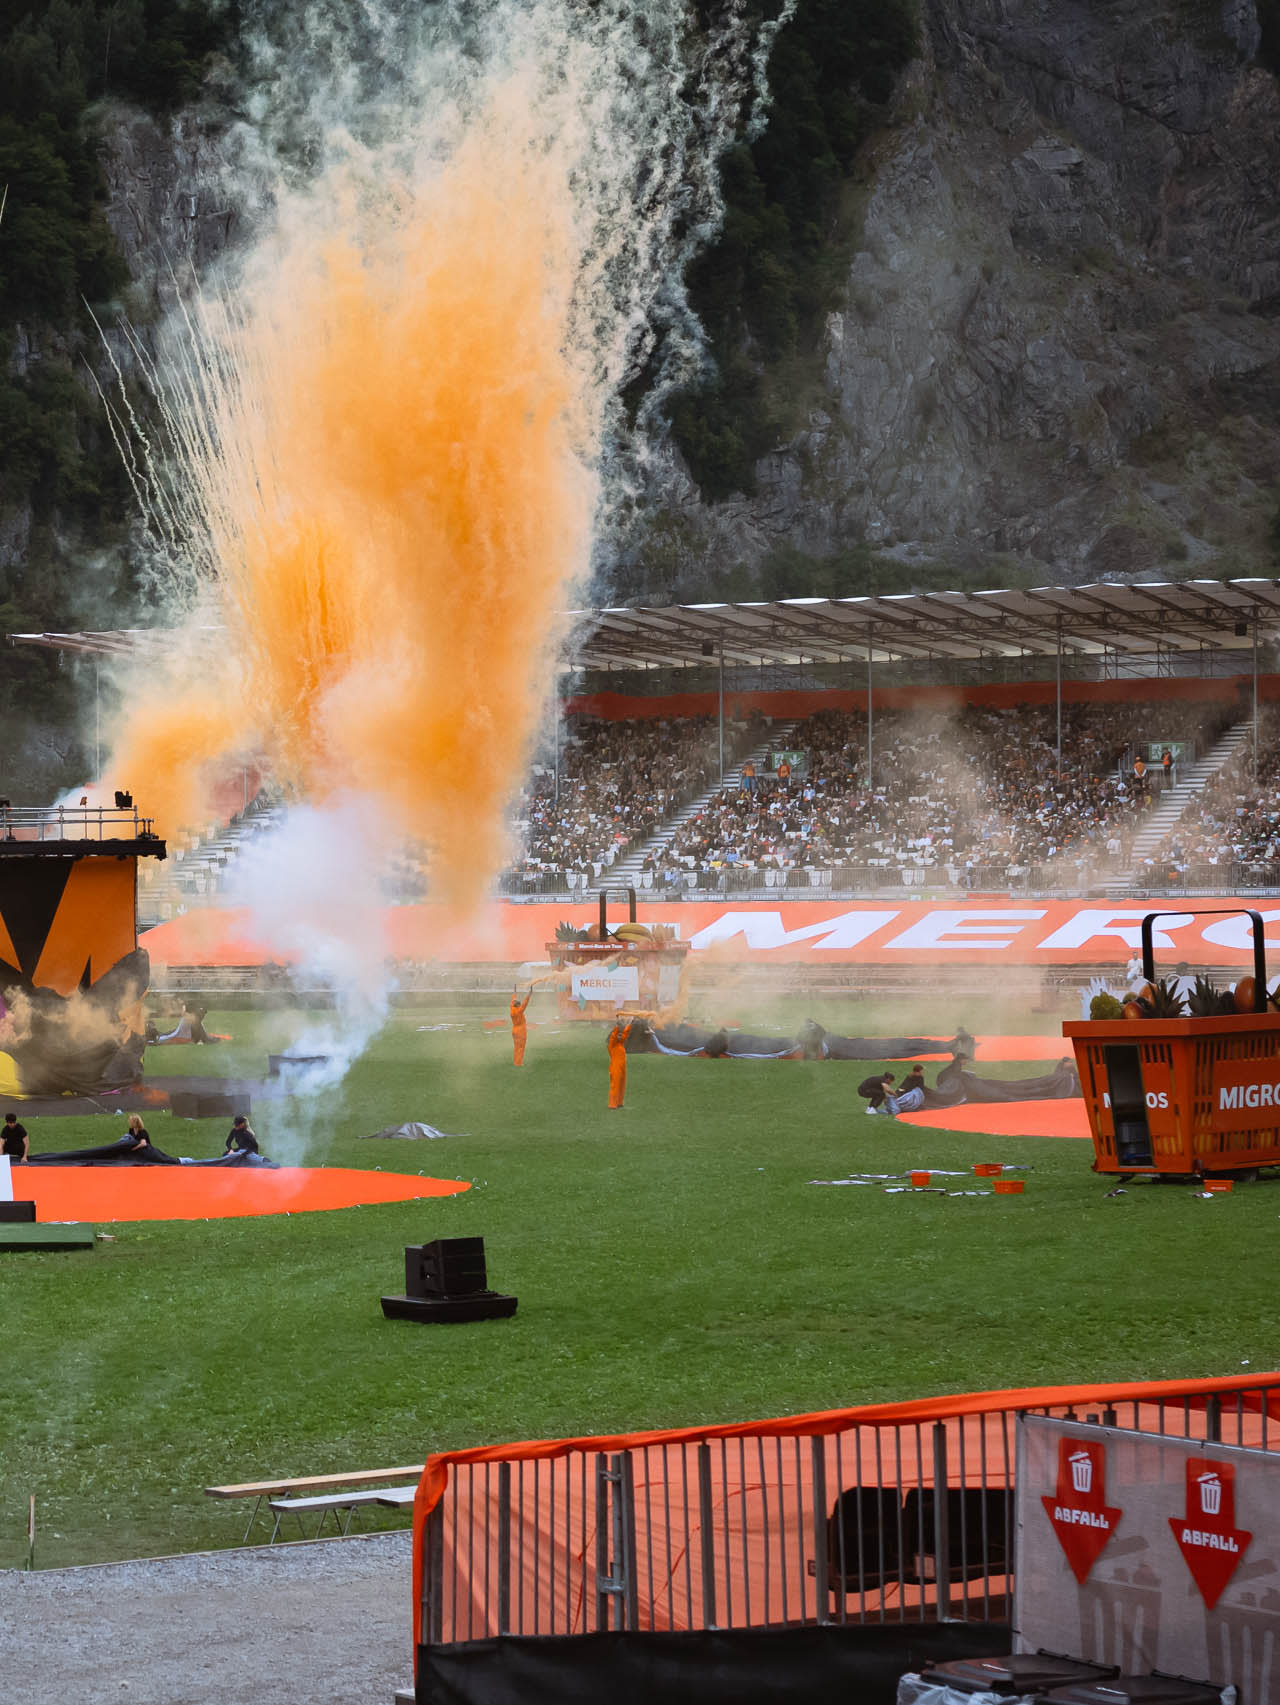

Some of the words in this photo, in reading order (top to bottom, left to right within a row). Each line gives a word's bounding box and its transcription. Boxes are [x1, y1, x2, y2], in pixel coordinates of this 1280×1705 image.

[580, 979, 612, 988] MERCI
[1054, 1506, 1110, 1529] ABFALL
[1181, 1528, 1239, 1553] ABFALL
